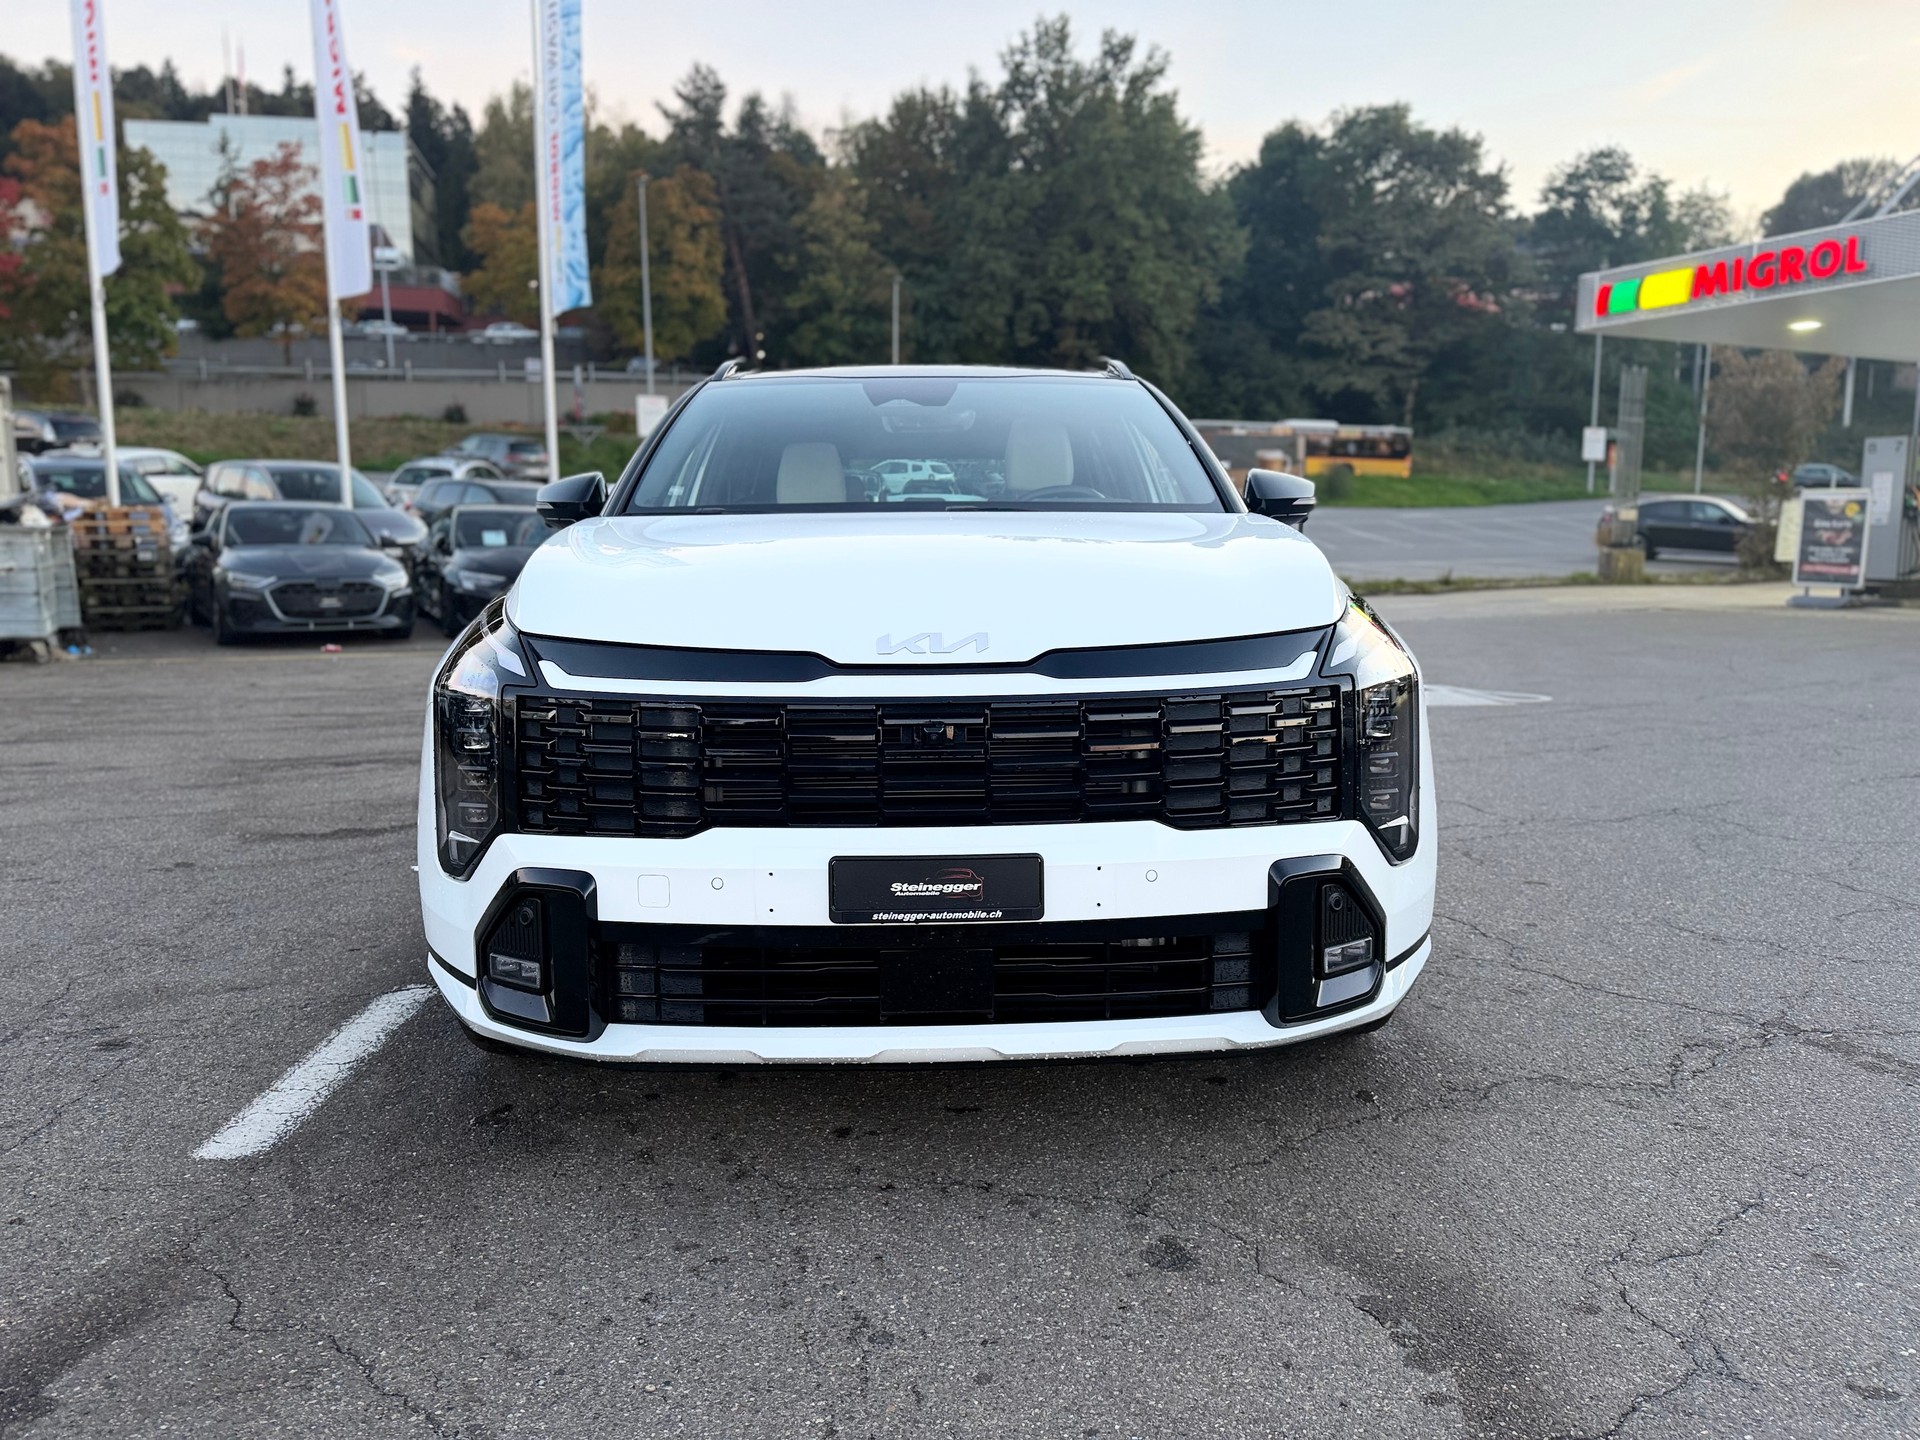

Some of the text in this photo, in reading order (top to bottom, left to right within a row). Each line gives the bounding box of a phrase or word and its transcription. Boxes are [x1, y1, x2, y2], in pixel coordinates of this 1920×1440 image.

[1691, 235, 1868, 300] MIGROL
[876, 632, 989, 655] KIA
[890, 882, 982, 893] Steinegger
[872, 910, 1003, 922] steinegger-automobile.ch
